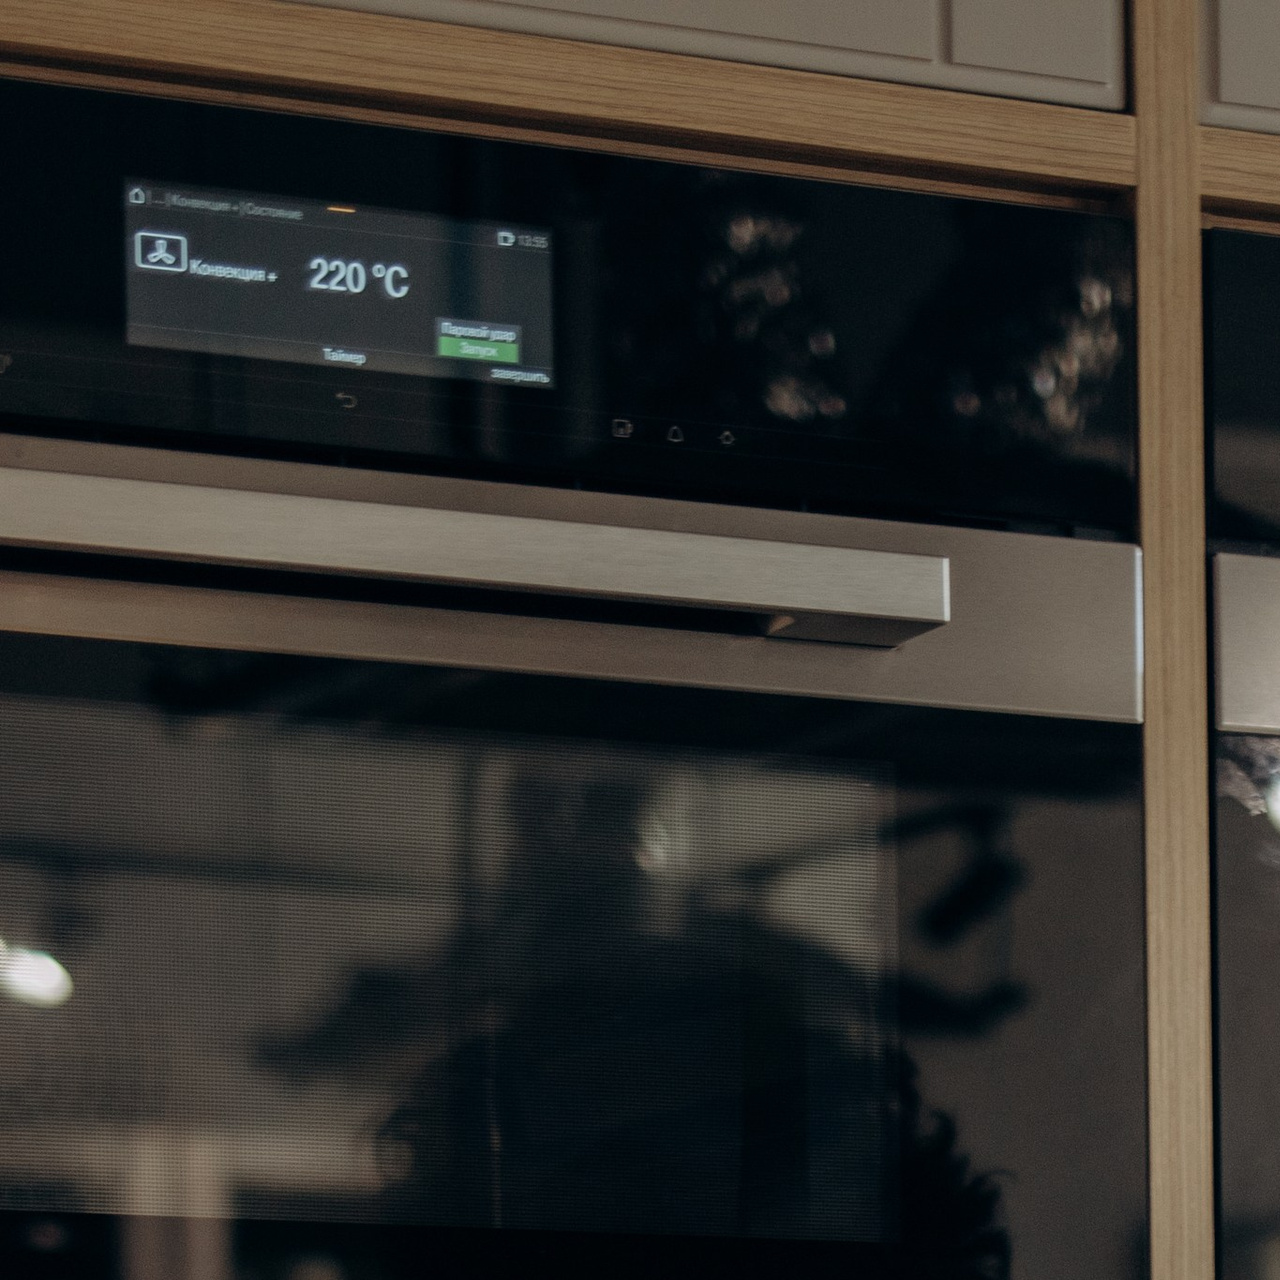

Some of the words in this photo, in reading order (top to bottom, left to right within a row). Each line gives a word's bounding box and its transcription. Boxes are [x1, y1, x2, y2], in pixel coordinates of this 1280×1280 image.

[190, 259, 266, 282] Конвекция
[309, 257, 367, 294] 220
[372, 262, 410, 299] °C
